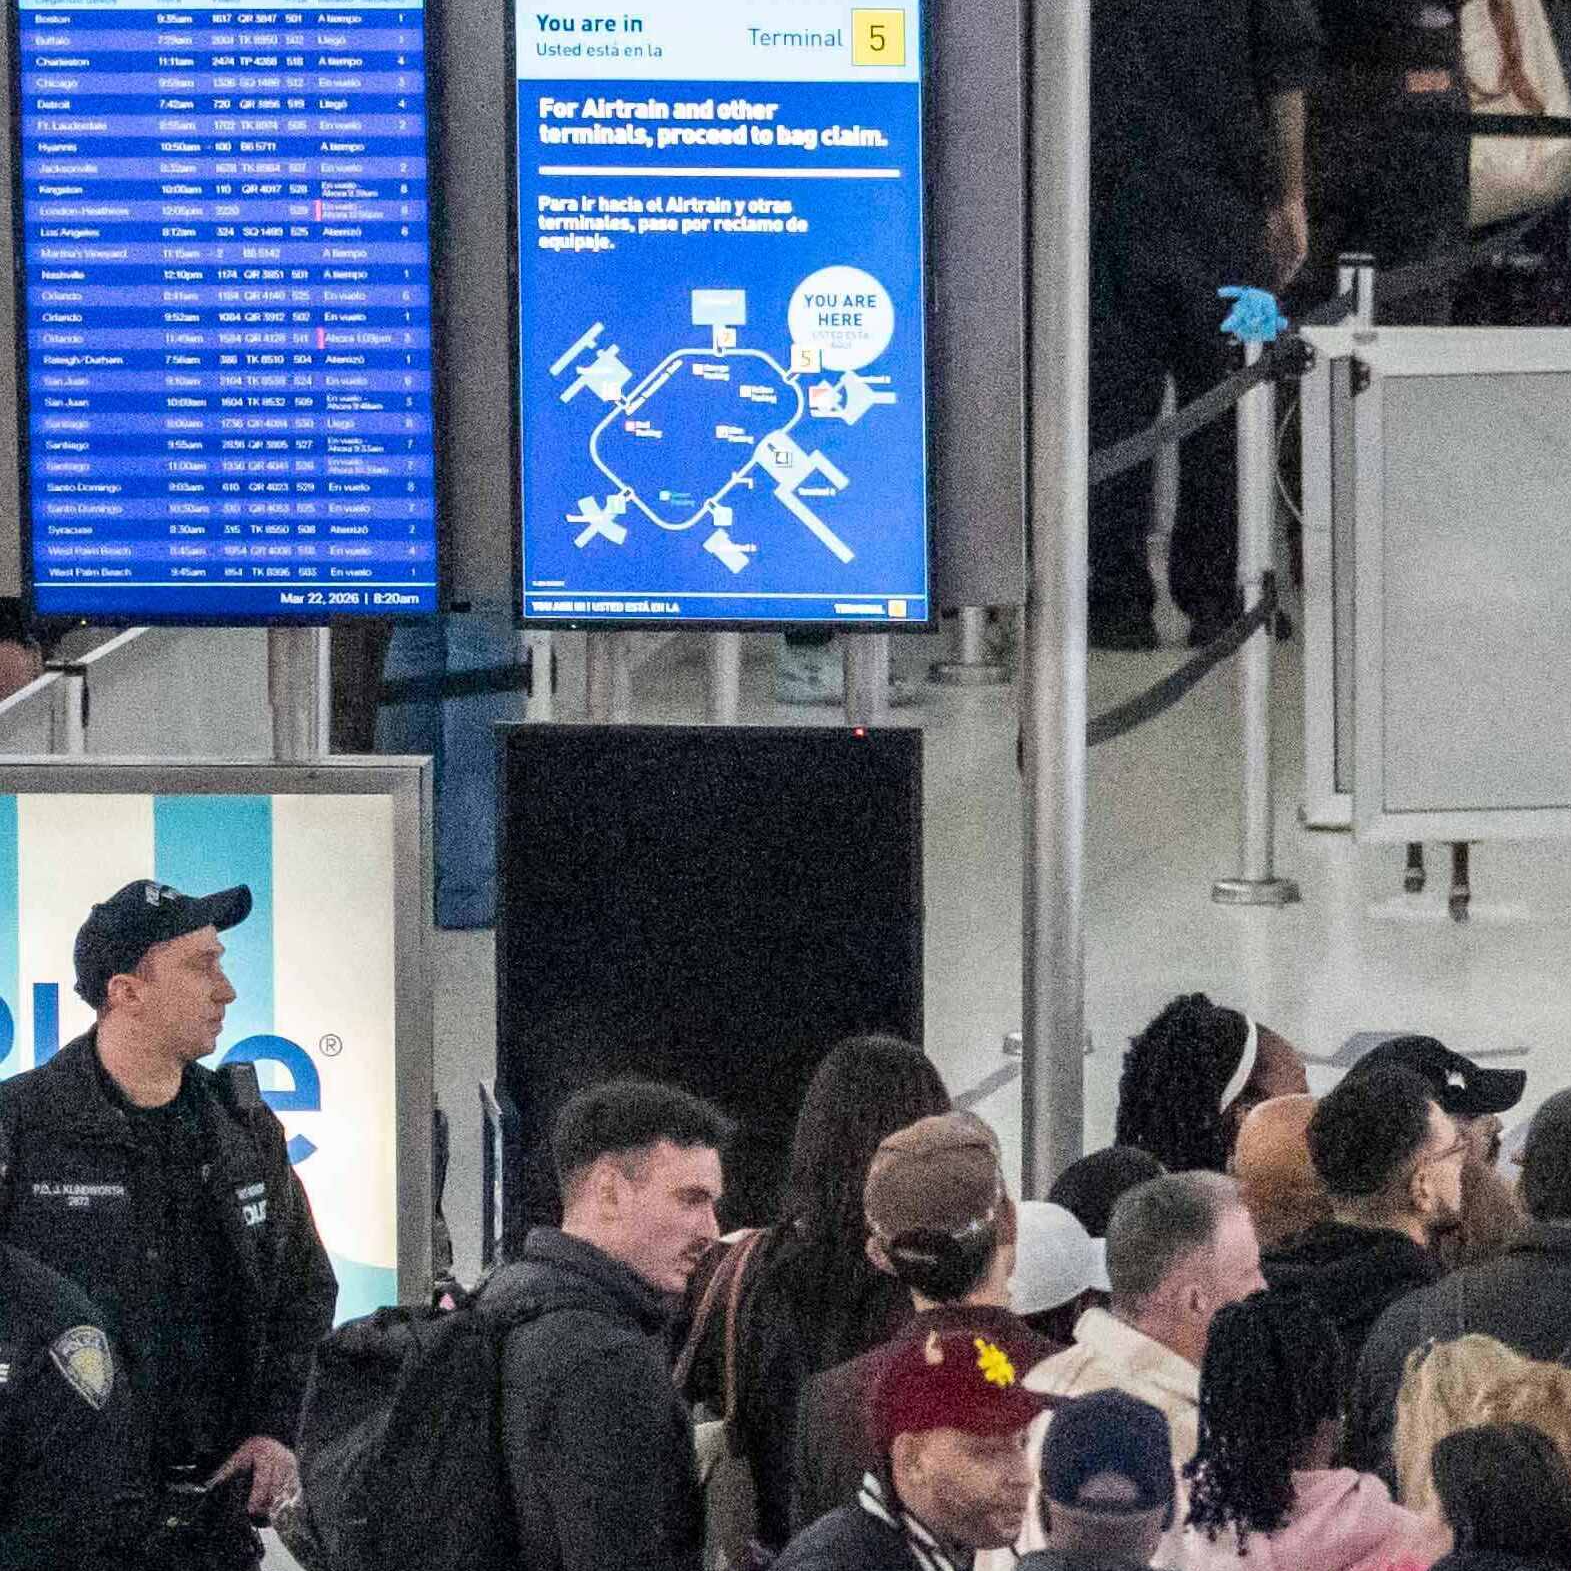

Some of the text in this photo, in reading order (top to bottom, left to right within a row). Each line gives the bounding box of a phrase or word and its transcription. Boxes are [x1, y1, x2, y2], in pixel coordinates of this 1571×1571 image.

[34, 14, 71, 24] Boston
[537, 14, 643, 33] You are in
[35, 36, 71, 46] Buffalo
[748, 24, 886, 52] Terminal 5
[536, 42, 581, 58] Usted
[624, 45, 643, 58] en
[647, 42, 663, 58] la
[36, 78, 79, 89] Chicago
[538, 98, 778, 120] For Airtrain and other
[539, 123, 889, 150] terminals, proceed to bag claim.
[38, 185, 83, 196] Kingston
[538, 195, 792, 217] Para ir hacia el Airtrain y otras
[538, 215, 634, 234] terminales,
[681, 218, 711, 236] por
[713, 216, 782, 232] reclamo
[785, 216, 808, 232] de
[60, 228, 100, 239] Angeles
[538, 233, 616, 252] equipaje.
[42, 291, 82, 301] Orlando
[804, 294, 878, 309] YOU ARE
[42, 313, 82, 322] Orlando
[817, 313, 863, 327] HERE
[42, 334, 84, 344] Orlando
[43, 355, 123, 366] Raleigh/Durham
[800, 350, 813, 367] 5
[44, 398, 90, 407] San Juan
[46, 441, 90, 451] Santiago
[47, 483, 122, 494] Santo Domingo
[48, 525, 93, 536] Syracuse
[48, 568, 132, 577] West Palm Beach
[280, 592, 305, 605] Mar
[307, 592, 326, 605] 22,
[329, 592, 360, 605] 2026
[373, 592, 419, 605] 8:20am
